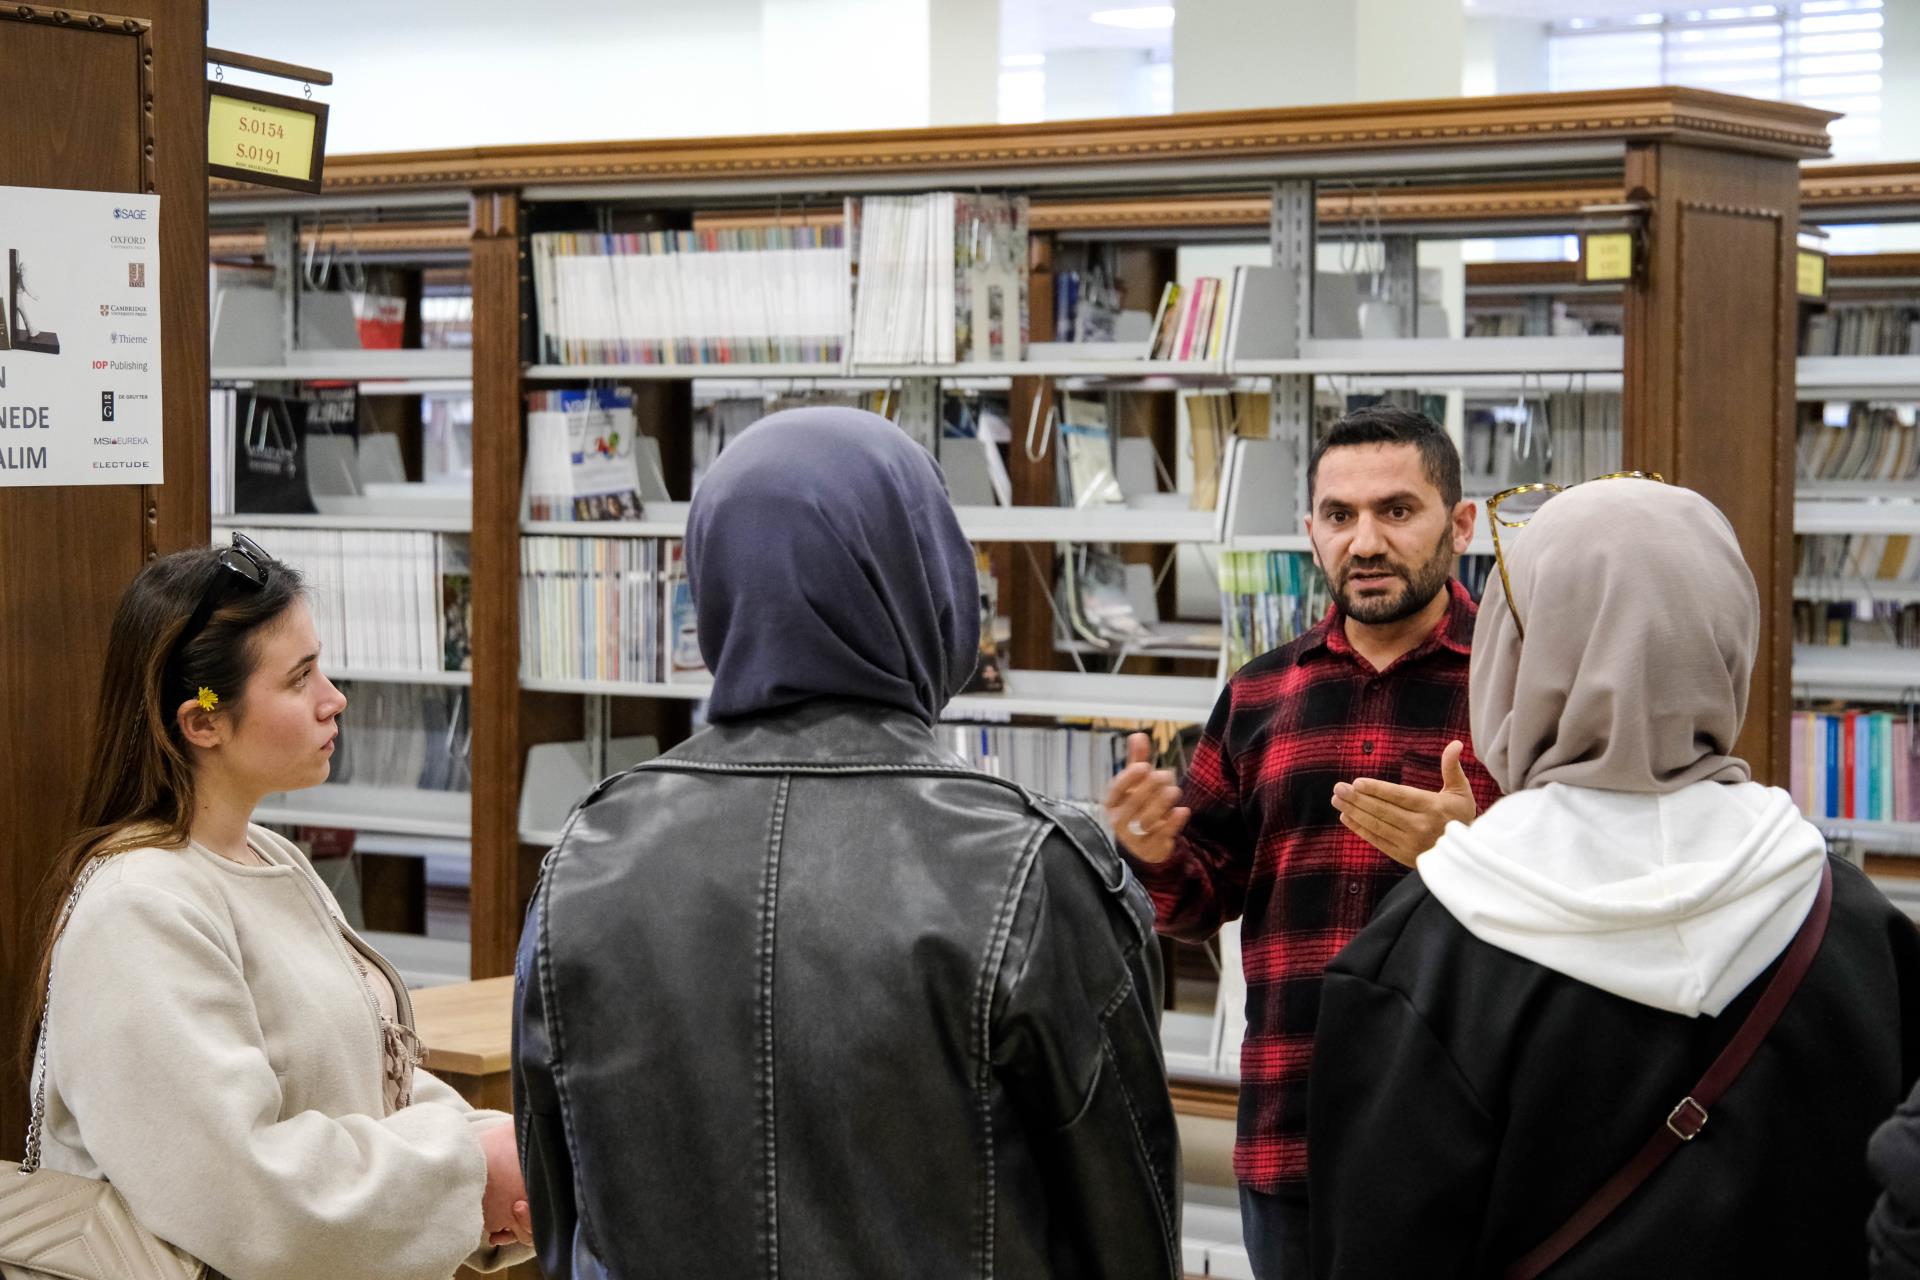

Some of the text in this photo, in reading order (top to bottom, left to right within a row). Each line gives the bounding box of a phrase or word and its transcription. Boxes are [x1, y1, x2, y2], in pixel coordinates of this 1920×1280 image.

[238, 116, 284, 139] S.0154
[236, 143, 280, 165] S.0191
[121, 208, 147, 220] SAGE
[110, 235, 146, 245] OXFORD
[110, 304, 147, 312] CAMBRIDGE
[119, 334, 148, 344] Thieme
[92, 360, 148, 373] IOP Publishing
[93, 437, 149, 445] MSI EUREKA
[92, 461, 150, 469] ELECTUDE
